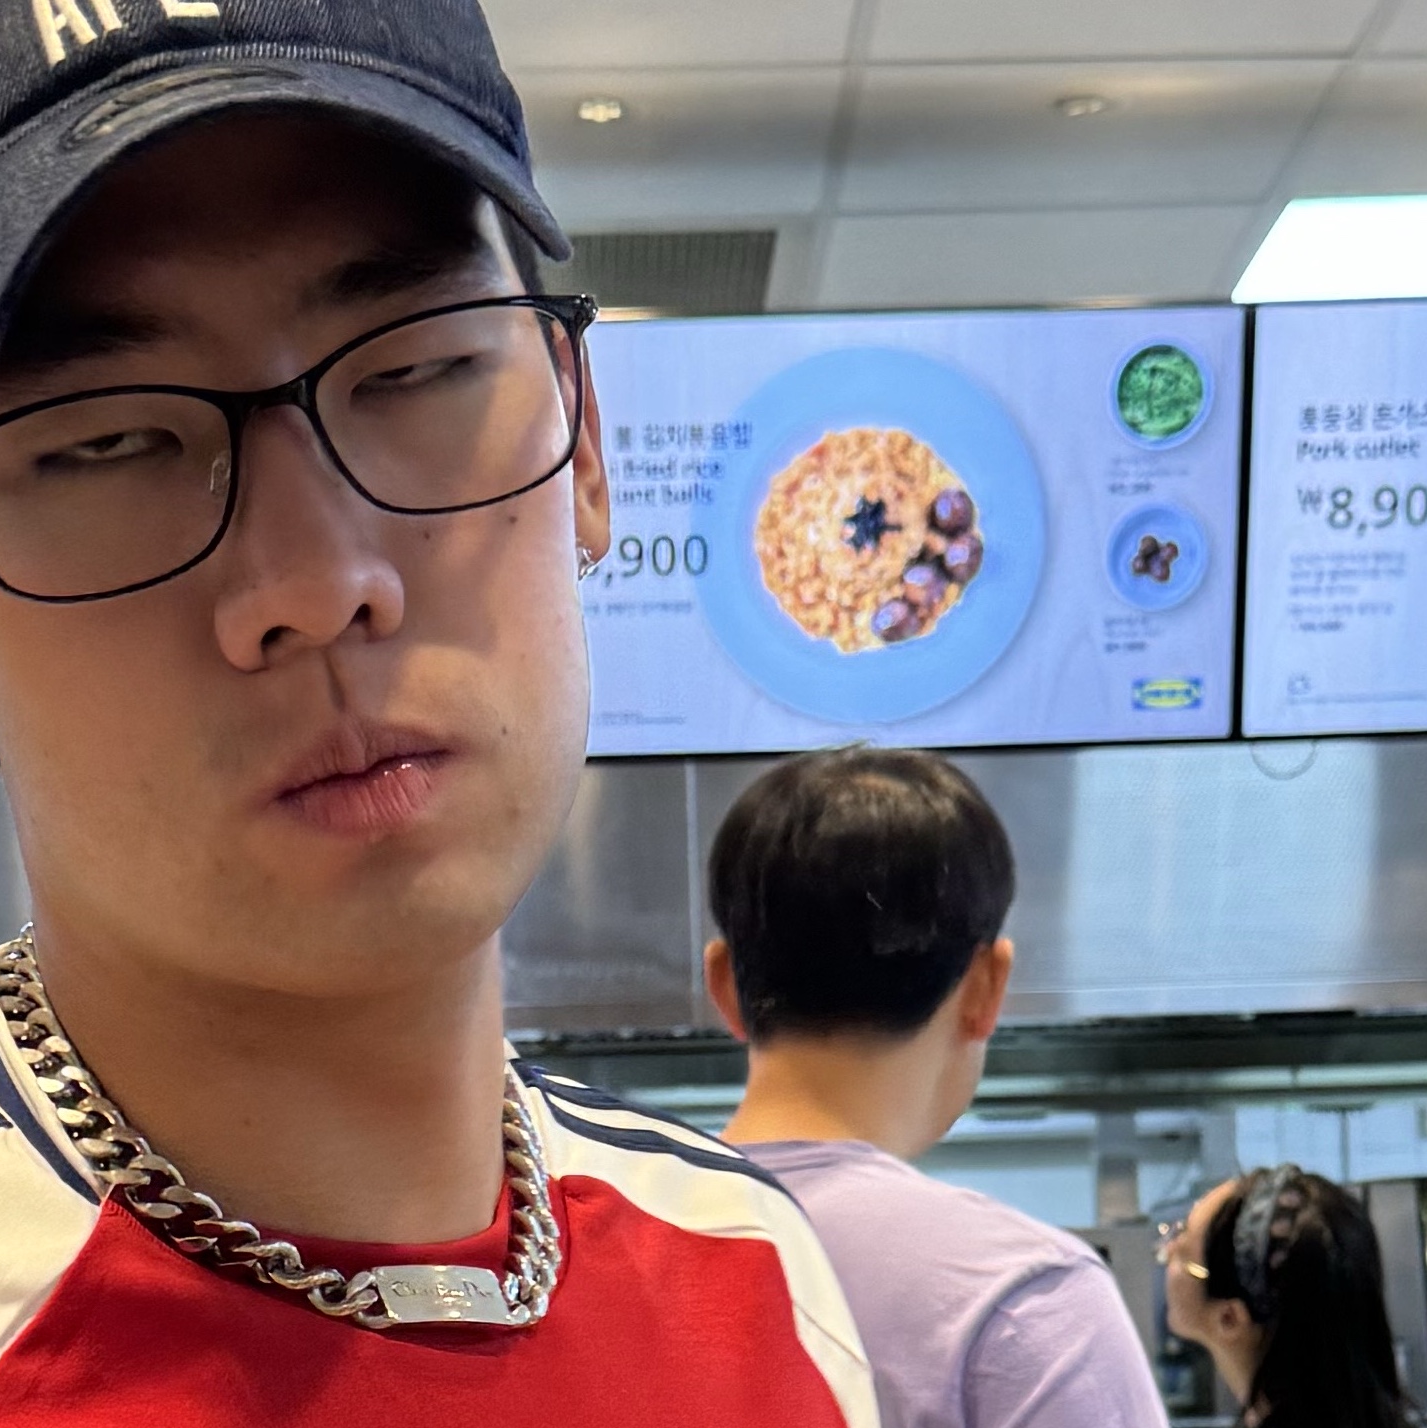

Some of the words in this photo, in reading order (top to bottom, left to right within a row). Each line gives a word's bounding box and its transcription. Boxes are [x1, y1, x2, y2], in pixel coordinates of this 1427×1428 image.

[1297, 438, 1348, 462] Pork
[1354, 434, 1421, 461] cutlet
[680, 459, 725, 480] rice
[615, 484, 656, 506] lant
[588, 533, 709, 588] ,900
